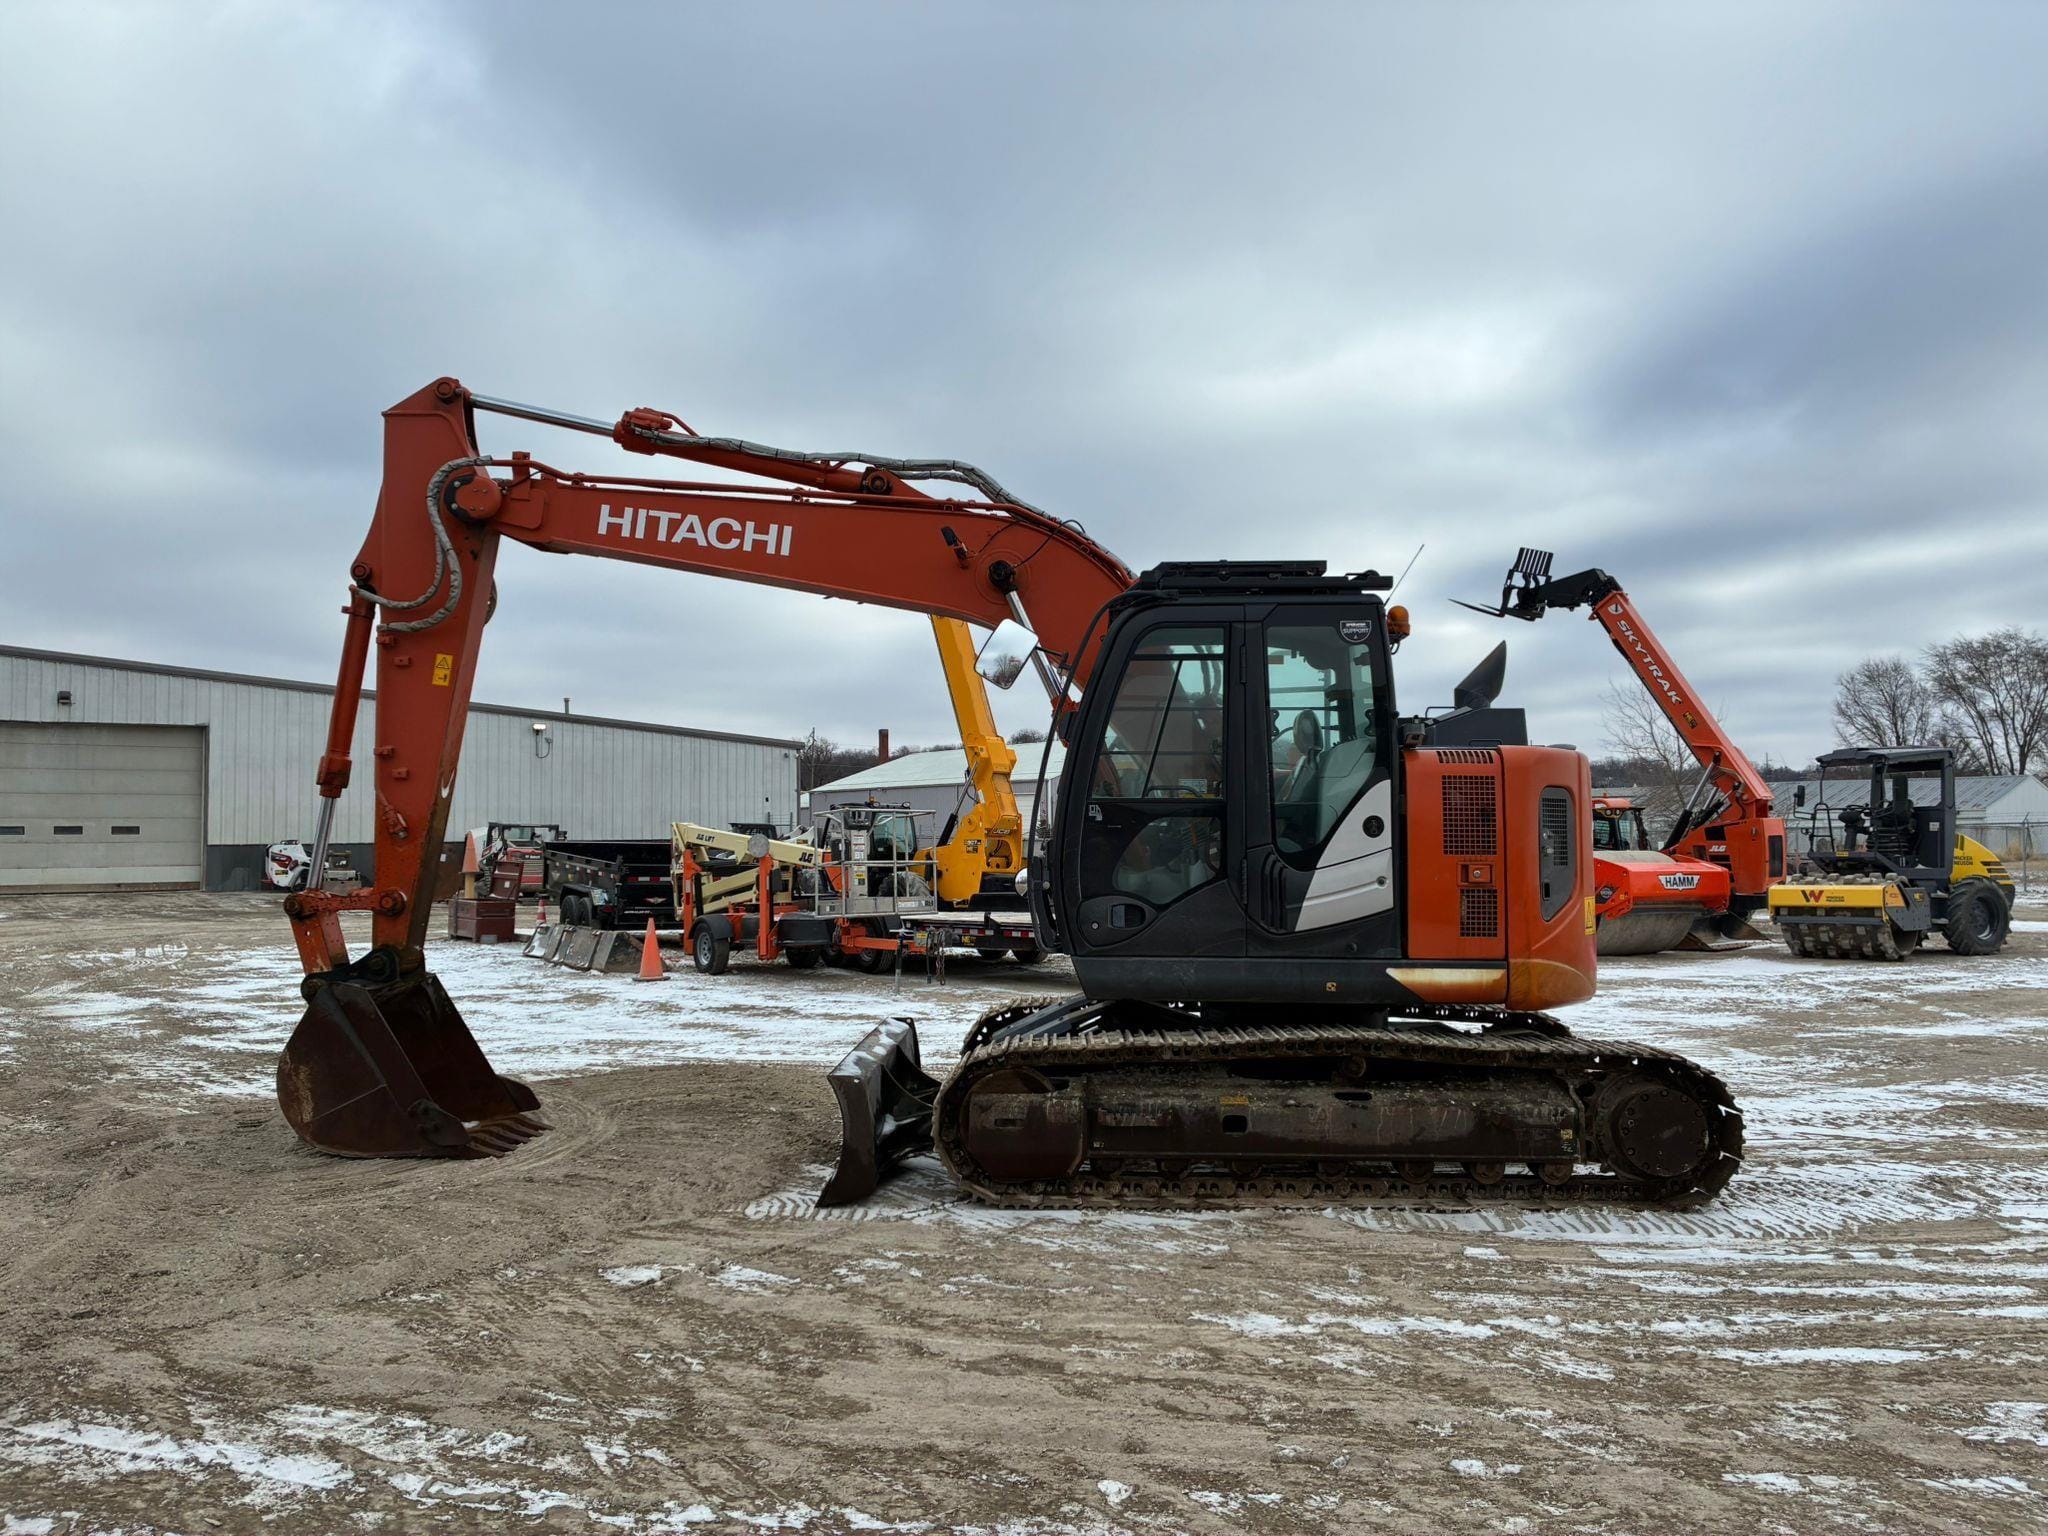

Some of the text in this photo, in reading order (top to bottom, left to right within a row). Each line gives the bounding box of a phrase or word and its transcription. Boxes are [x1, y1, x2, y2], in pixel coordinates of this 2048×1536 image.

[597, 503, 793, 556] HITACHI
[1616, 619, 1682, 705] SKYTRAK
[705, 834, 715, 842] LIFT
[799, 851, 814, 863] JLG
[1665, 877, 1695, 888] HAMM
